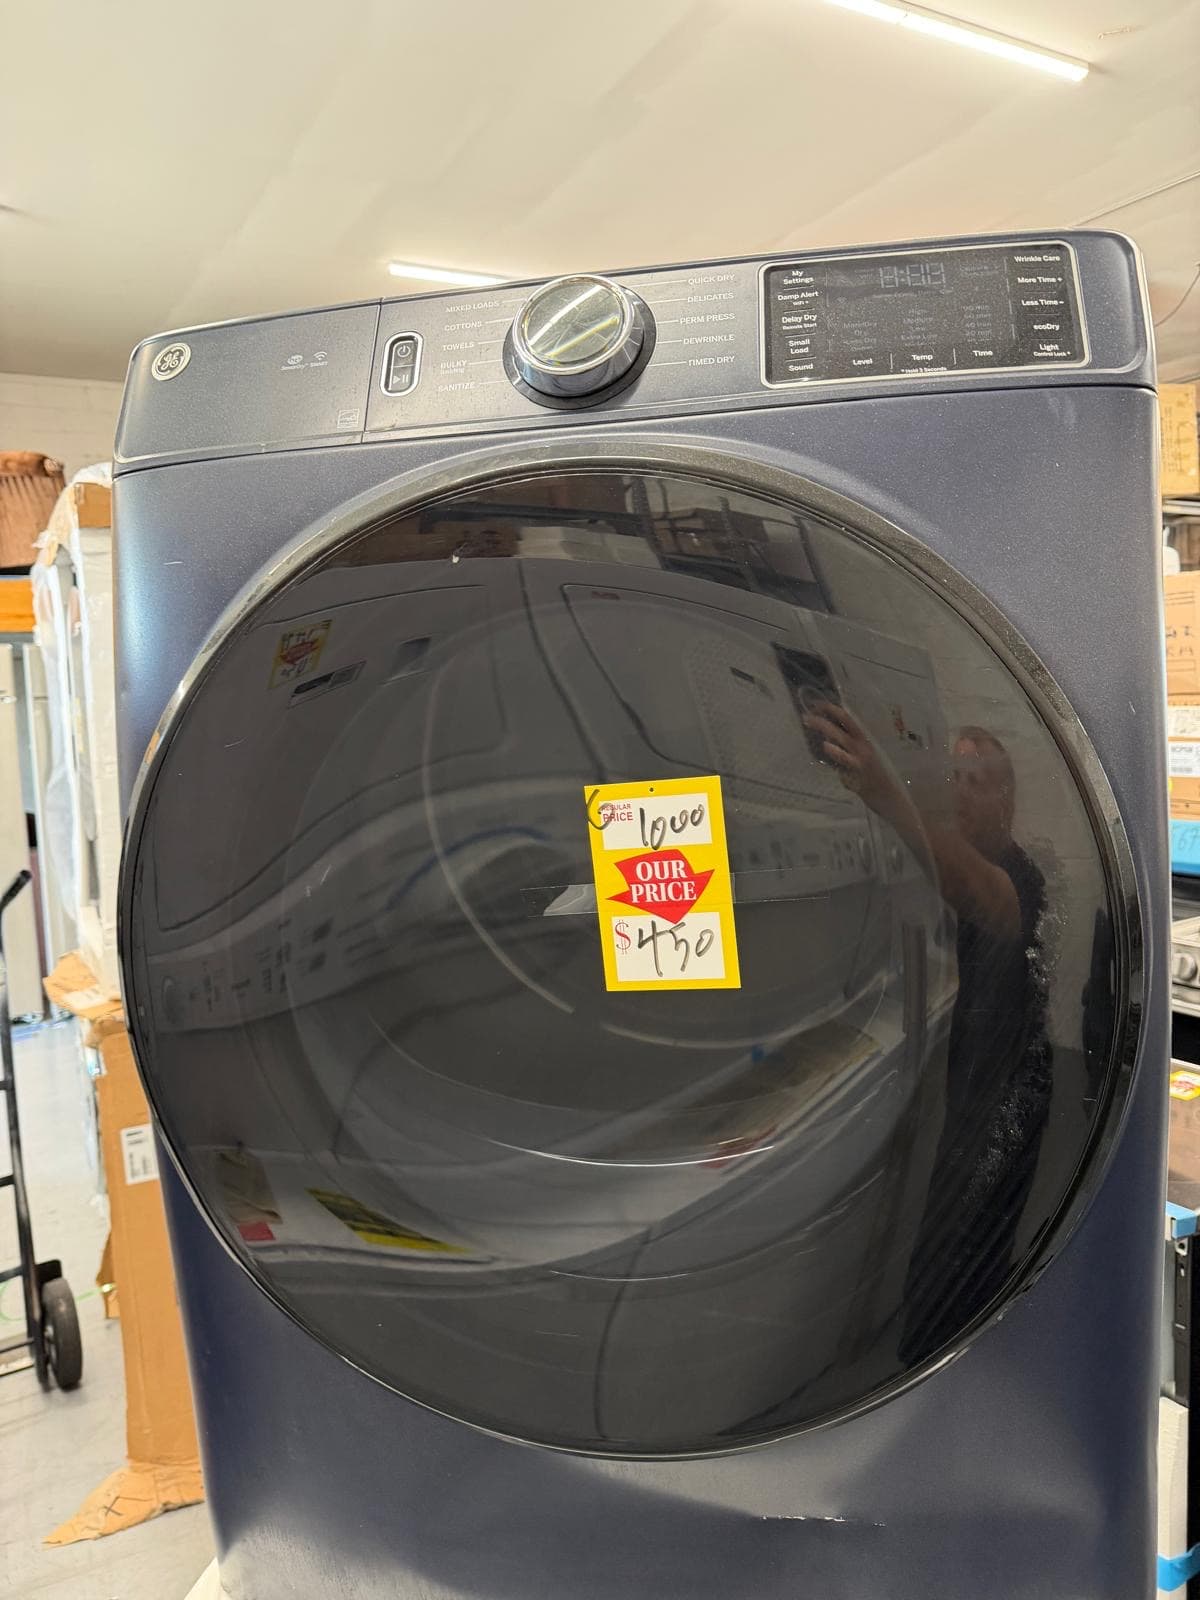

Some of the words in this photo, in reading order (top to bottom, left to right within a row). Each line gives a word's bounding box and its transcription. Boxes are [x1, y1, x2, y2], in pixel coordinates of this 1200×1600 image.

[1014, 255, 1042, 263] Wrinkle
[1043, 254, 1061, 262] Care
[688, 276, 716, 285] QUICK
[717, 274, 735, 282] DRY
[792, 270, 804, 278] My
[783, 276, 814, 285] Settings
[687, 292, 735, 303] DELICATES
[777, 293, 800, 302] Damp
[800, 290, 819, 299] Alert
[445, 304, 471, 313] MIXED
[473, 301, 499, 310] LOADS
[680, 315, 705, 325] PERM
[706, 312, 736, 322] PRESS
[782, 315, 803, 325] Delay
[803, 313, 818, 322] Dry
[444, 320, 482, 332] COTTONS
[1033, 322, 1060, 331] ecoDry
[683, 333, 736, 345] DEWRINKLE
[788, 338, 811, 347] Small
[442, 341, 475, 352] TOWELS
[790, 346, 809, 355] Load
[1039, 343, 1060, 351] Light
[972, 349, 994, 357] Time
[440, 359, 467, 369] BULKY
[688, 357, 715, 367] TIMED
[717, 355, 735, 364] DRY
[852, 357, 873, 366] Level
[788, 363, 814, 372] Sound
[438, 381, 477, 392] SANITIZE
[602, 811, 634, 822] PRICE
[639, 803, 705, 851] 1000
[635, 859, 688, 882] OUR
[630, 881, 697, 903] PRICE
